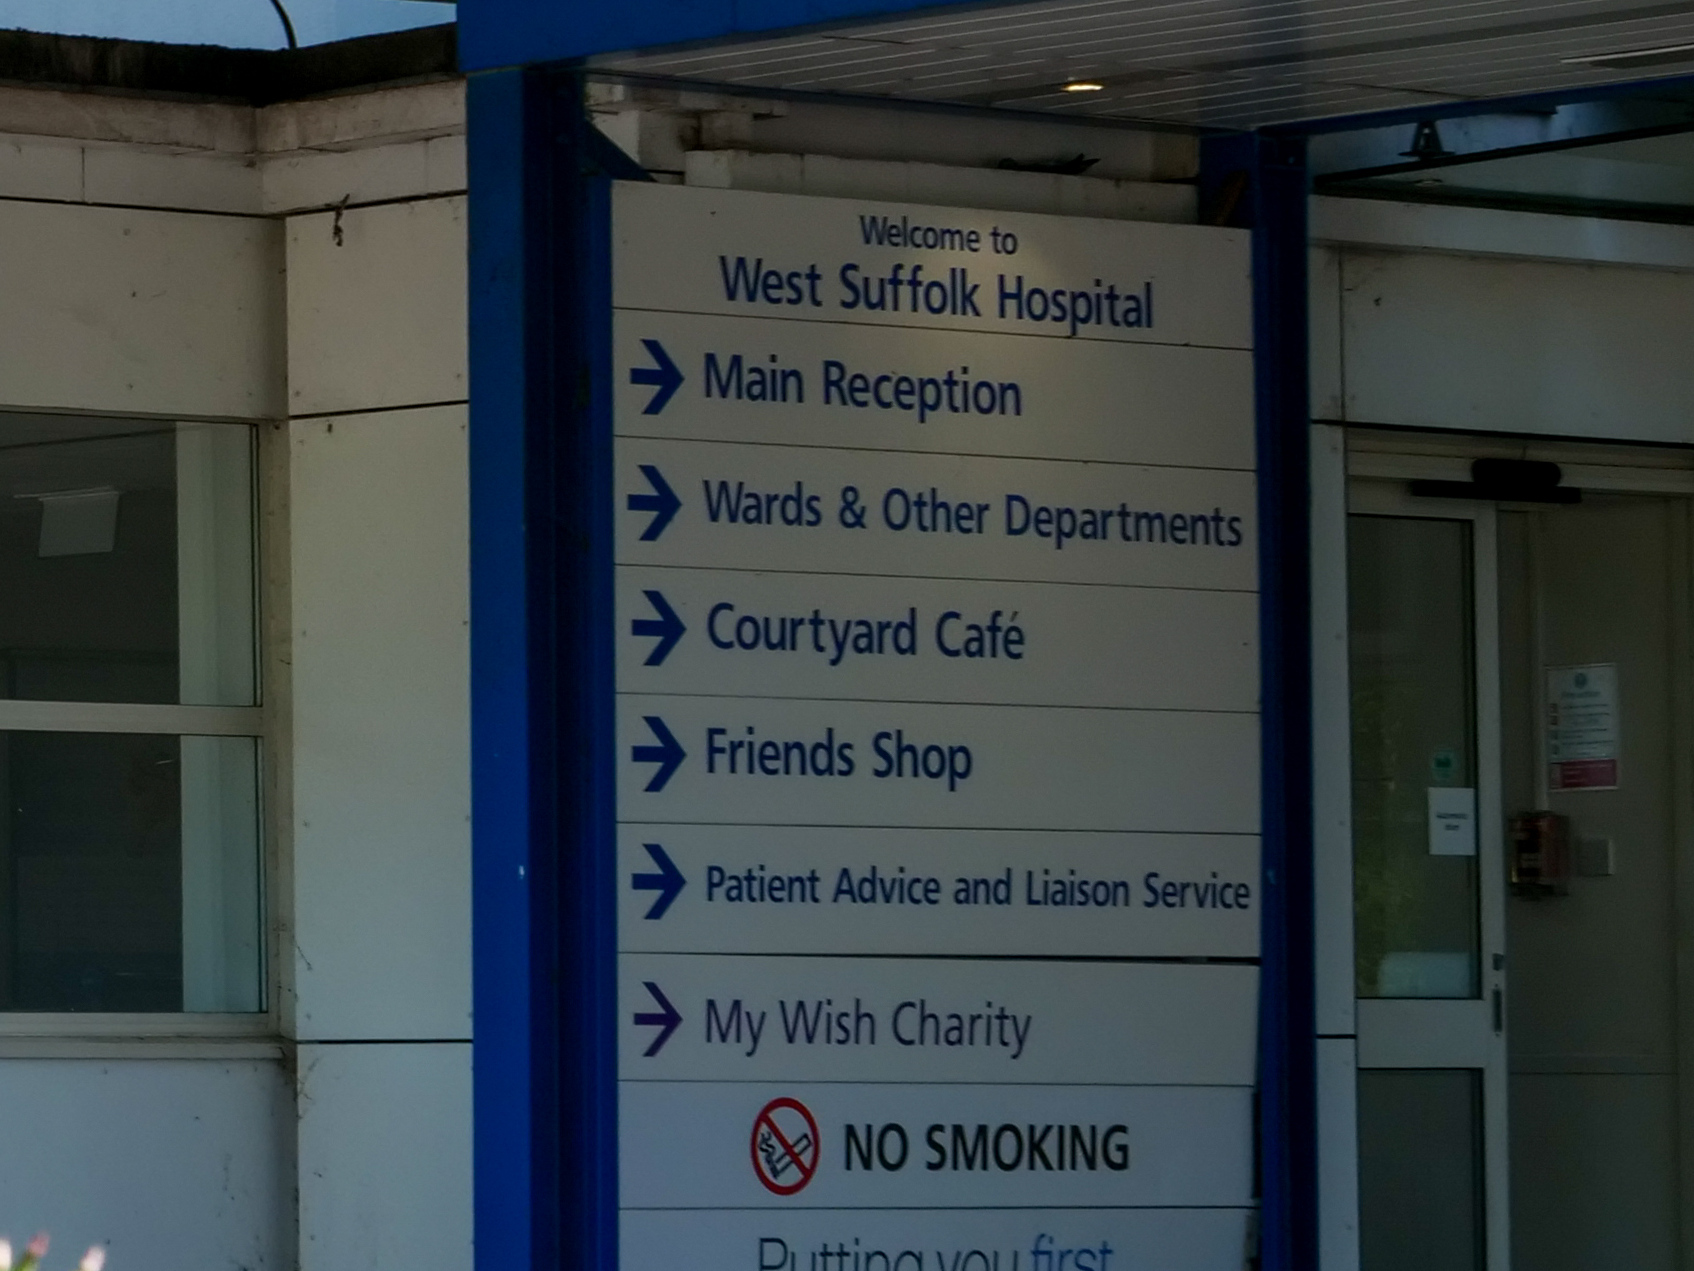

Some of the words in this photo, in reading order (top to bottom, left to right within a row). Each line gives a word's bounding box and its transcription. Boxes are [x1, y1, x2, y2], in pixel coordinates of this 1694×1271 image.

[858, 214, 980, 253] Welcome
[989, 225, 1019, 256] to
[718, 255, 823, 308] West
[838, 262, 982, 317] Suffolk
[998, 275, 1154, 337] Hospital
[704, 352, 804, 404] Main
[822, 359, 1022, 424] Reception
[702, 479, 822, 527] Wards
[838, 485, 867, 529] &
[882, 487, 990, 535] Other
[1005, 494, 1244, 550] Departments
[707, 602, 917, 667] Courtyard
[935, 610, 1025, 660] Café
[707, 726, 855, 777] Friends
[872, 729, 973, 792] Shop
[707, 864, 821, 904] Patient
[832, 865, 941, 905] Advice
[953, 867, 1012, 906] and
[1026, 868, 1130, 907] Liaison
[1143, 871, 1251, 910] Service
[706, 998, 767, 1058] My
[779, 997, 876, 1045] Wish
[891, 998, 1032, 1060] Charity
[845, 1122, 909, 1172] NO
[925, 1123, 1129, 1172] SMOKING
